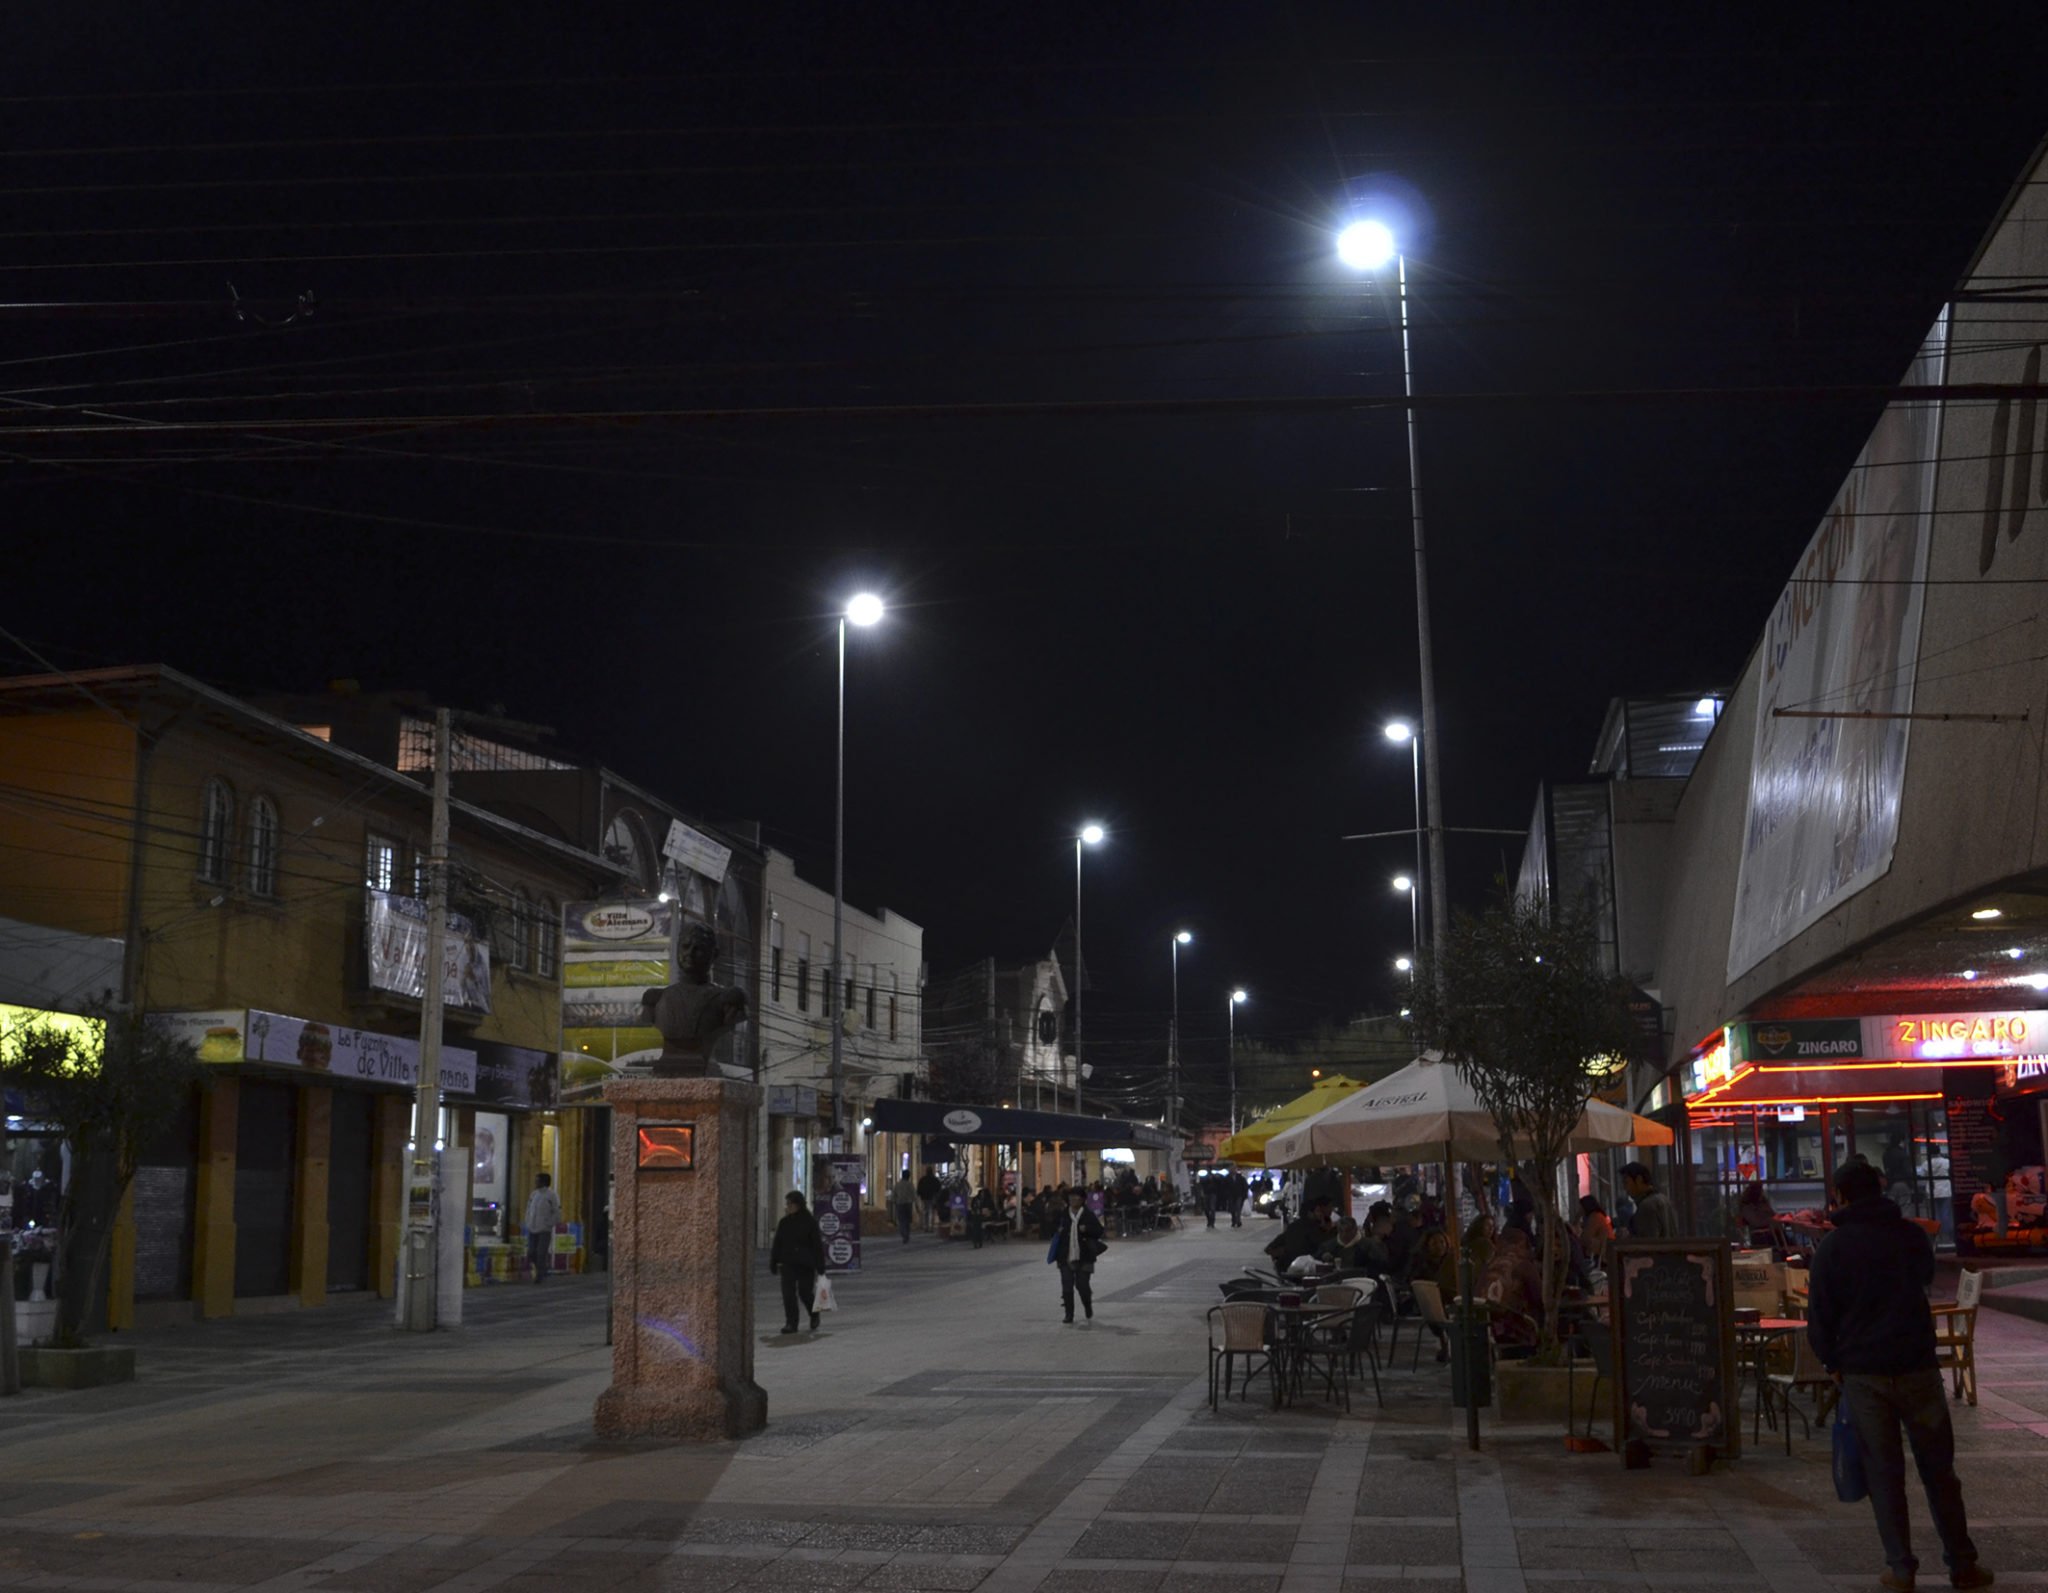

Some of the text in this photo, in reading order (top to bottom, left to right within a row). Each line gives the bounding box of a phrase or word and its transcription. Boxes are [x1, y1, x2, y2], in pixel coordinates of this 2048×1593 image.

[605, 918, 648, 927] Alemana
[1896, 1016, 2028, 1044] ZINGARO
[338, 1028, 389, 1053] La Fuente
[1796, 1040, 1858, 1055] ZINGARO
[357, 1051, 375, 1076] de
[380, 1053, 410, 1081] Villa
[1362, 1091, 1428, 1107] AUSTRAL
